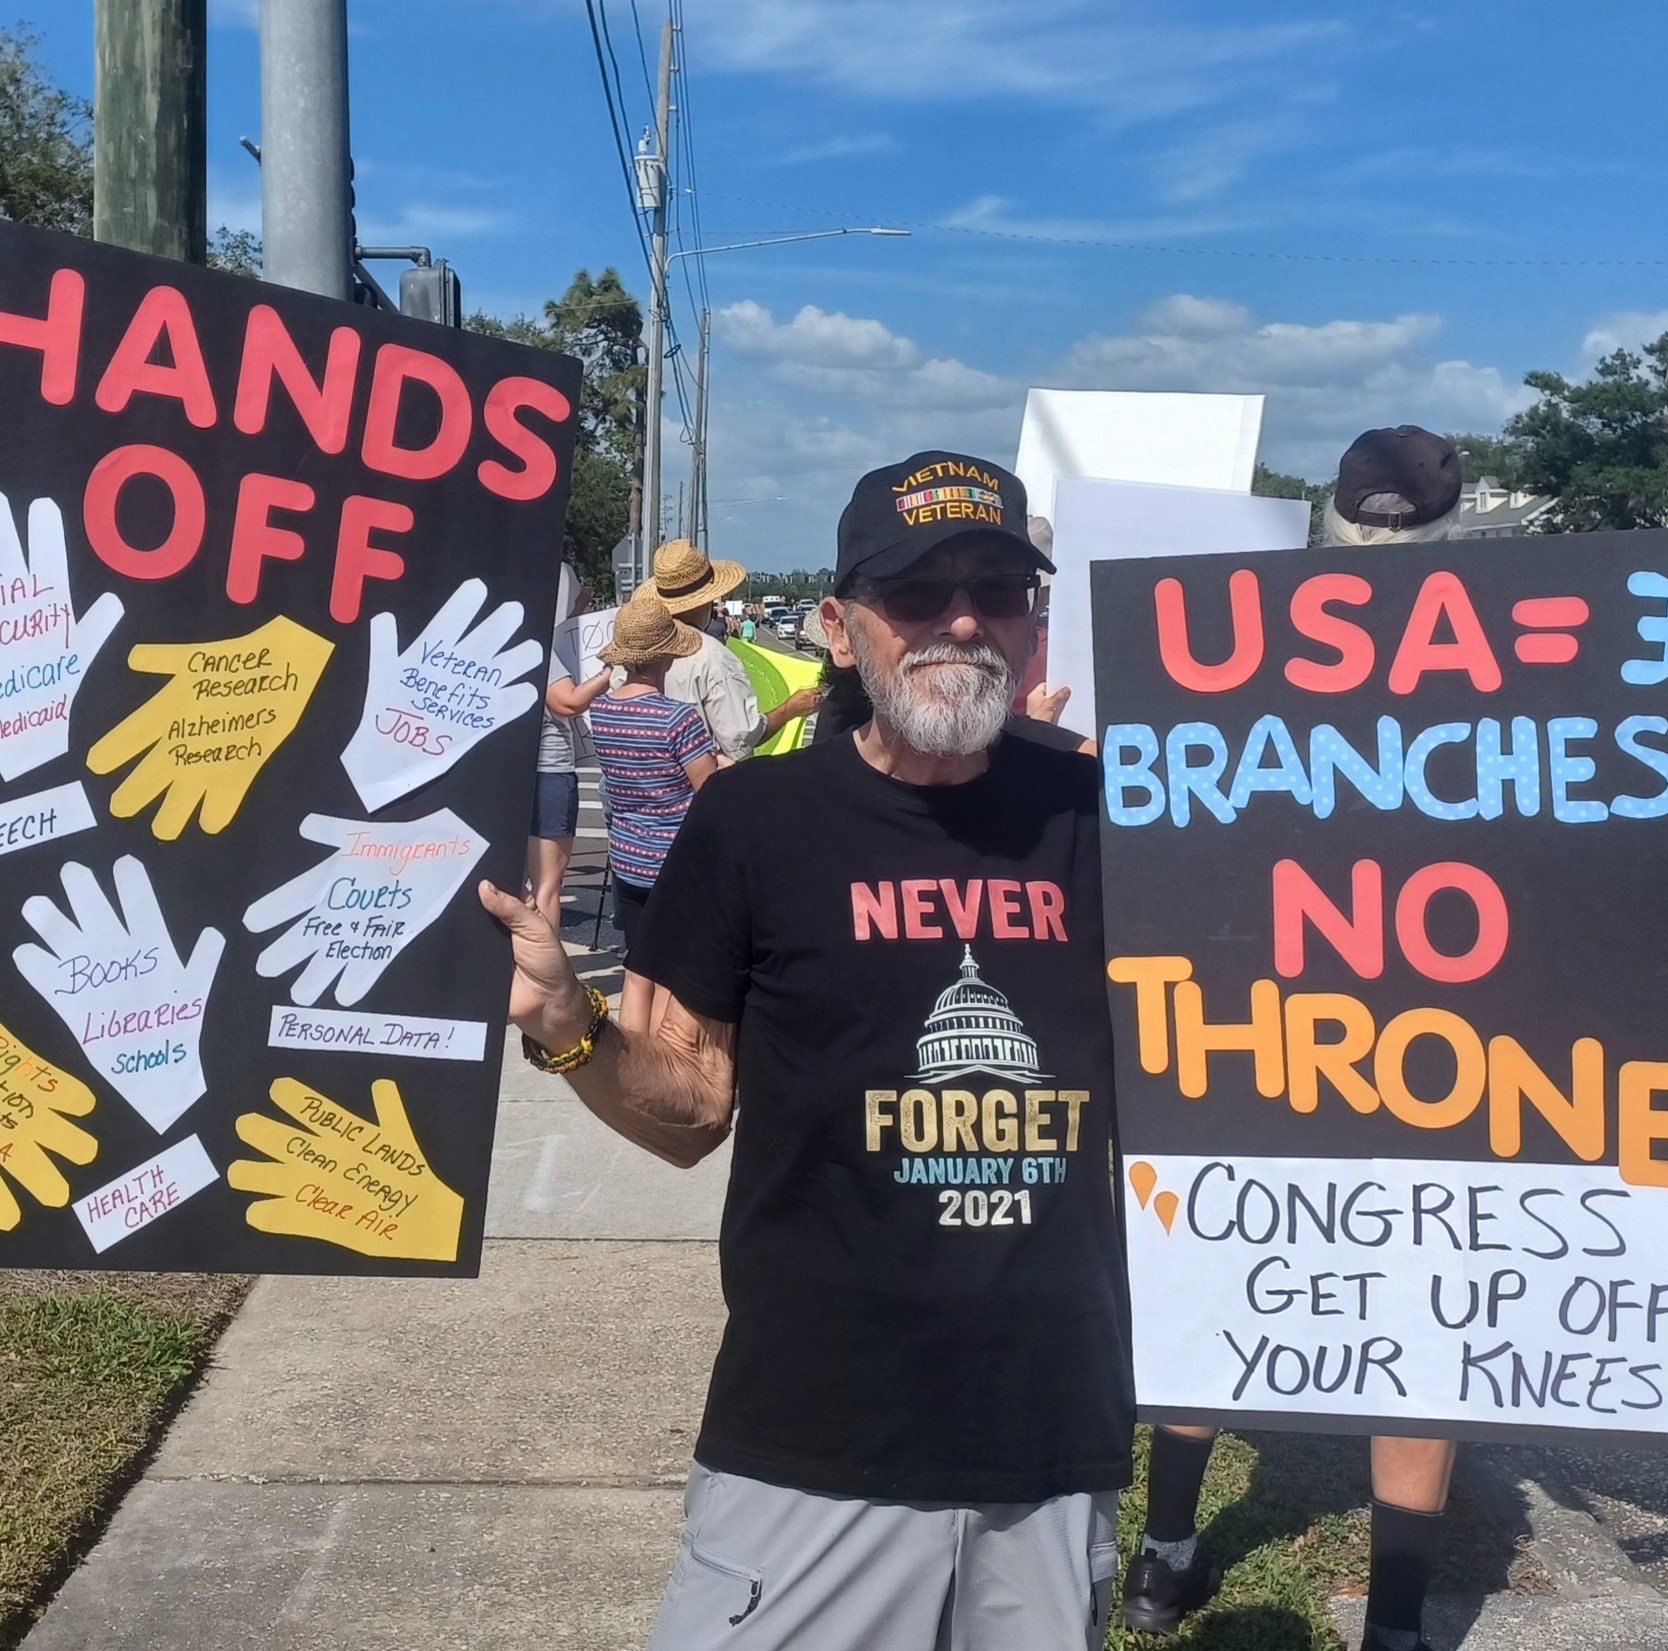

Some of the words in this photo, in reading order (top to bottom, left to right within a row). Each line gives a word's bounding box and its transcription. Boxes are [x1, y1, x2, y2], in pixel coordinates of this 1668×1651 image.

[0, 268, 570, 500] HANDS
[892, 461, 999, 492] VIETNAM
[83, 444, 414, 623] OFF
[903, 502, 1002, 526] VETERAN
[0, 654, 80, 699] dicare
[400, 668, 491, 709] Benefits
[0, 694, 67, 739] edicaid
[168, 708, 276, 740] Alzheimers
[376, 708, 452, 755] JOBS
[1103, 714, 1668, 828] BRANCHES
[303, 917, 342, 937] Free
[850, 879, 1068, 942] NEVER
[1272, 858, 1509, 983] NO
[325, 941, 393, 960] Election
[278, 1013, 374, 1045] PERSONAL
[1107, 956, 1668, 1188] THRONE
[300, 1096, 363, 1142] PUBLIC
[362, 1133, 426, 1177] LANDS
[865, 1089, 1090, 1153] FORGET
[86, 1164, 164, 1223] HEALTH
[894, 1157, 1014, 1185] JANUARY
[1022, 1157, 1067, 1184] 6TH
[124, 1181, 181, 1229] CARE
[938, 1189, 1032, 1226] 2021
[1187, 1161, 1631, 1260] CONGRESS
[1246, 1256, 1387, 1320] GET
[1431, 1269, 1527, 1329] UP
[1558, 1276, 1668, 1342] OFF
[1222, 1330, 1407, 1401] YOUR
[1460, 1341, 1663, 1413] KNEES
